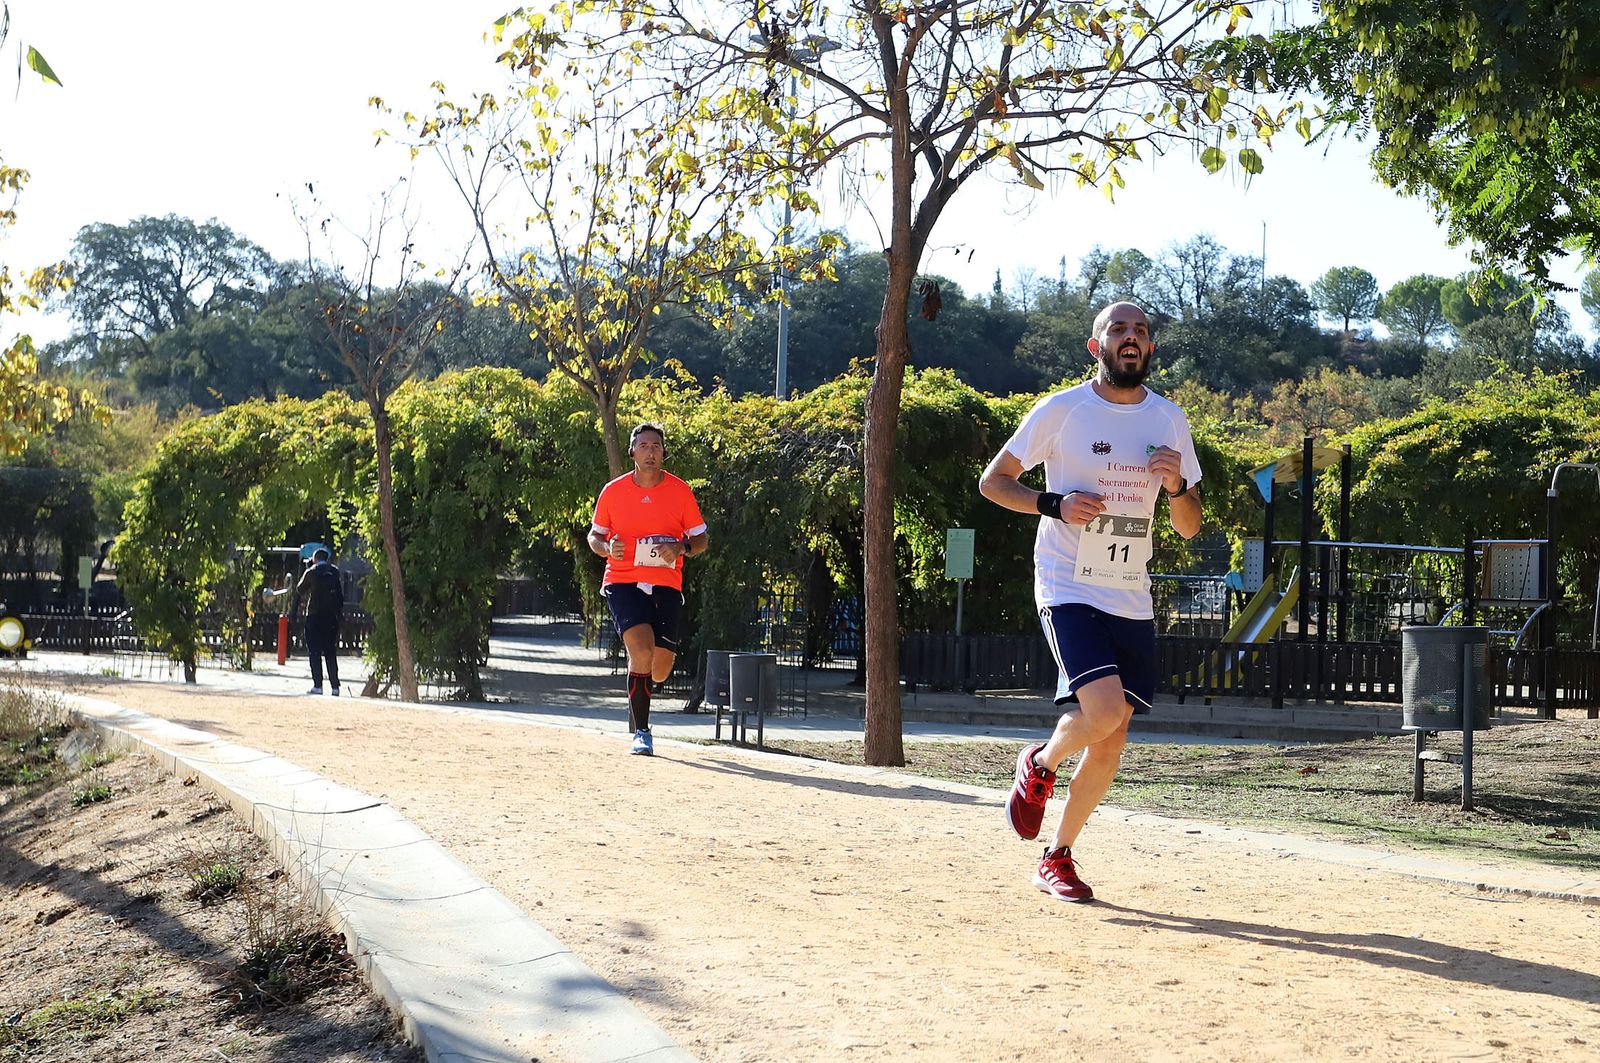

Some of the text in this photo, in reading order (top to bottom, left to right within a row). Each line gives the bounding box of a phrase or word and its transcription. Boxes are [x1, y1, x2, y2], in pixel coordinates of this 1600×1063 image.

[1107, 462, 1146, 473] I Carrera
[1098, 477, 1150, 489] Sacramental
[650, 548, 661, 558] 5
[1107, 543, 1130, 563] 11
